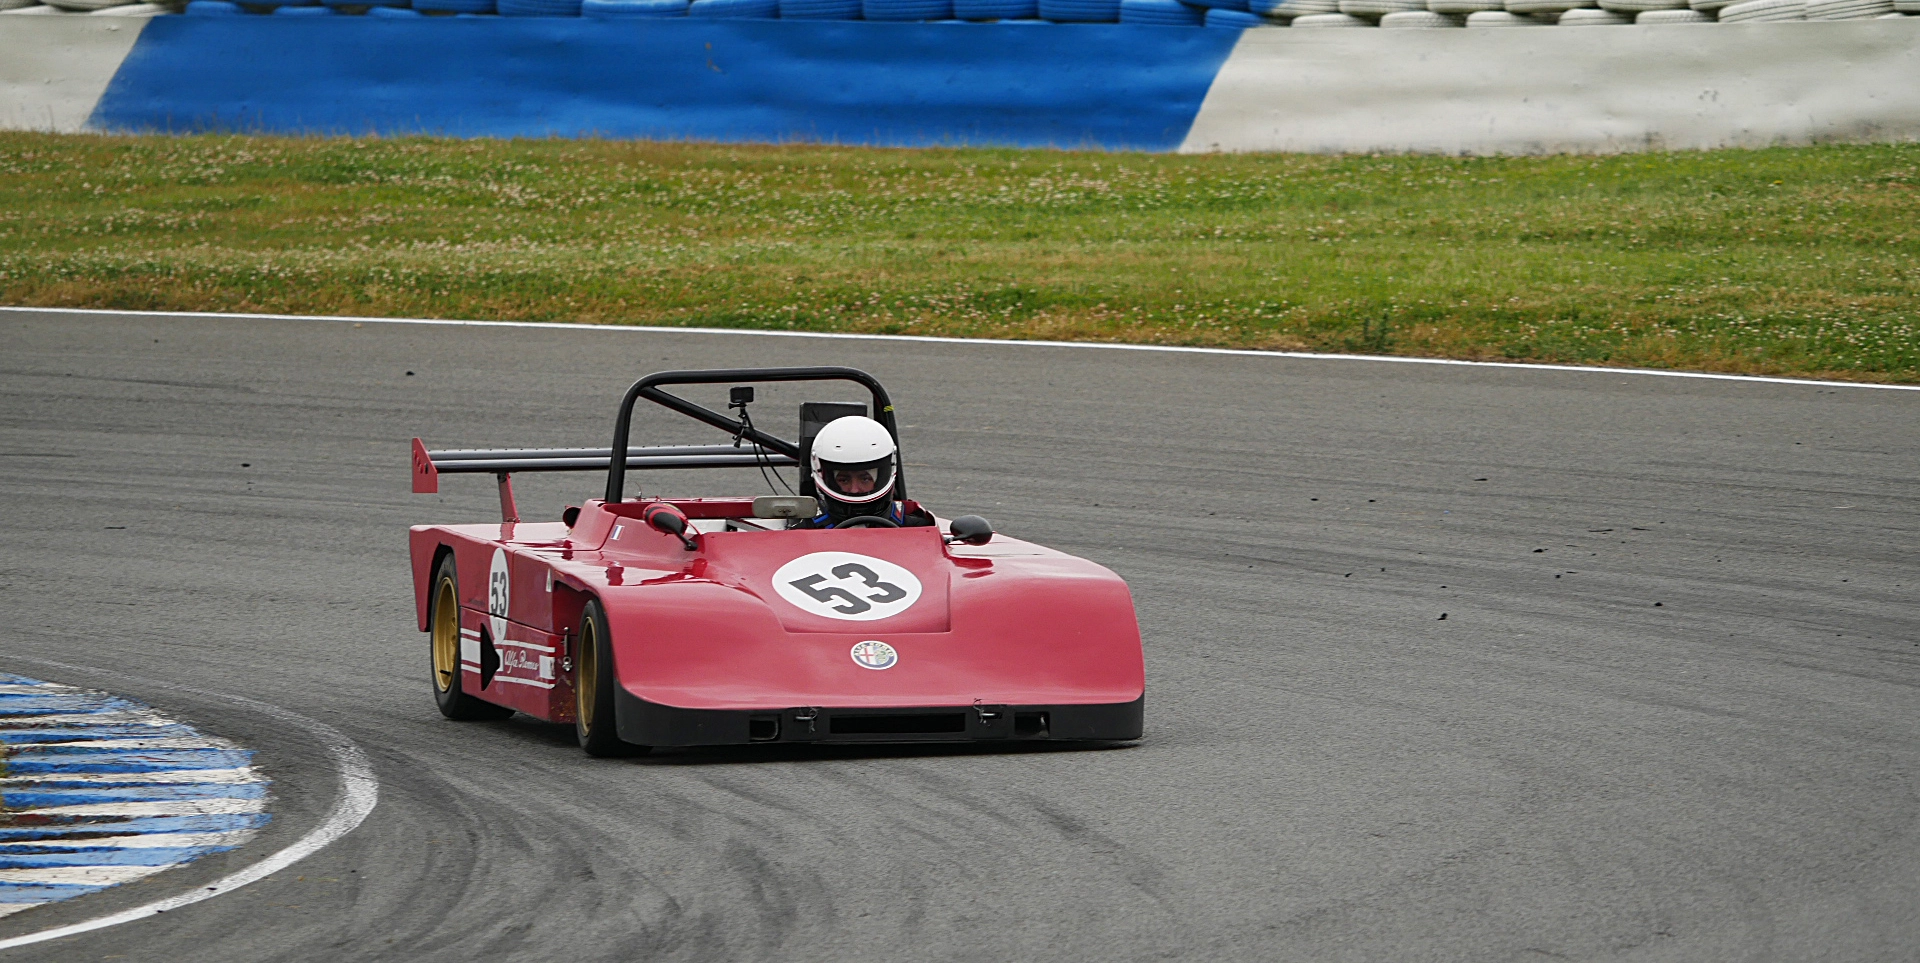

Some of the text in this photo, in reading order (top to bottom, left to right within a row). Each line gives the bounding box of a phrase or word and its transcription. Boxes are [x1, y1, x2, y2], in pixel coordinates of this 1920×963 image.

[491, 571, 507, 616] 53
[788, 562, 907, 615] 53
[505, 650, 540, 674] Alfa Romeo
